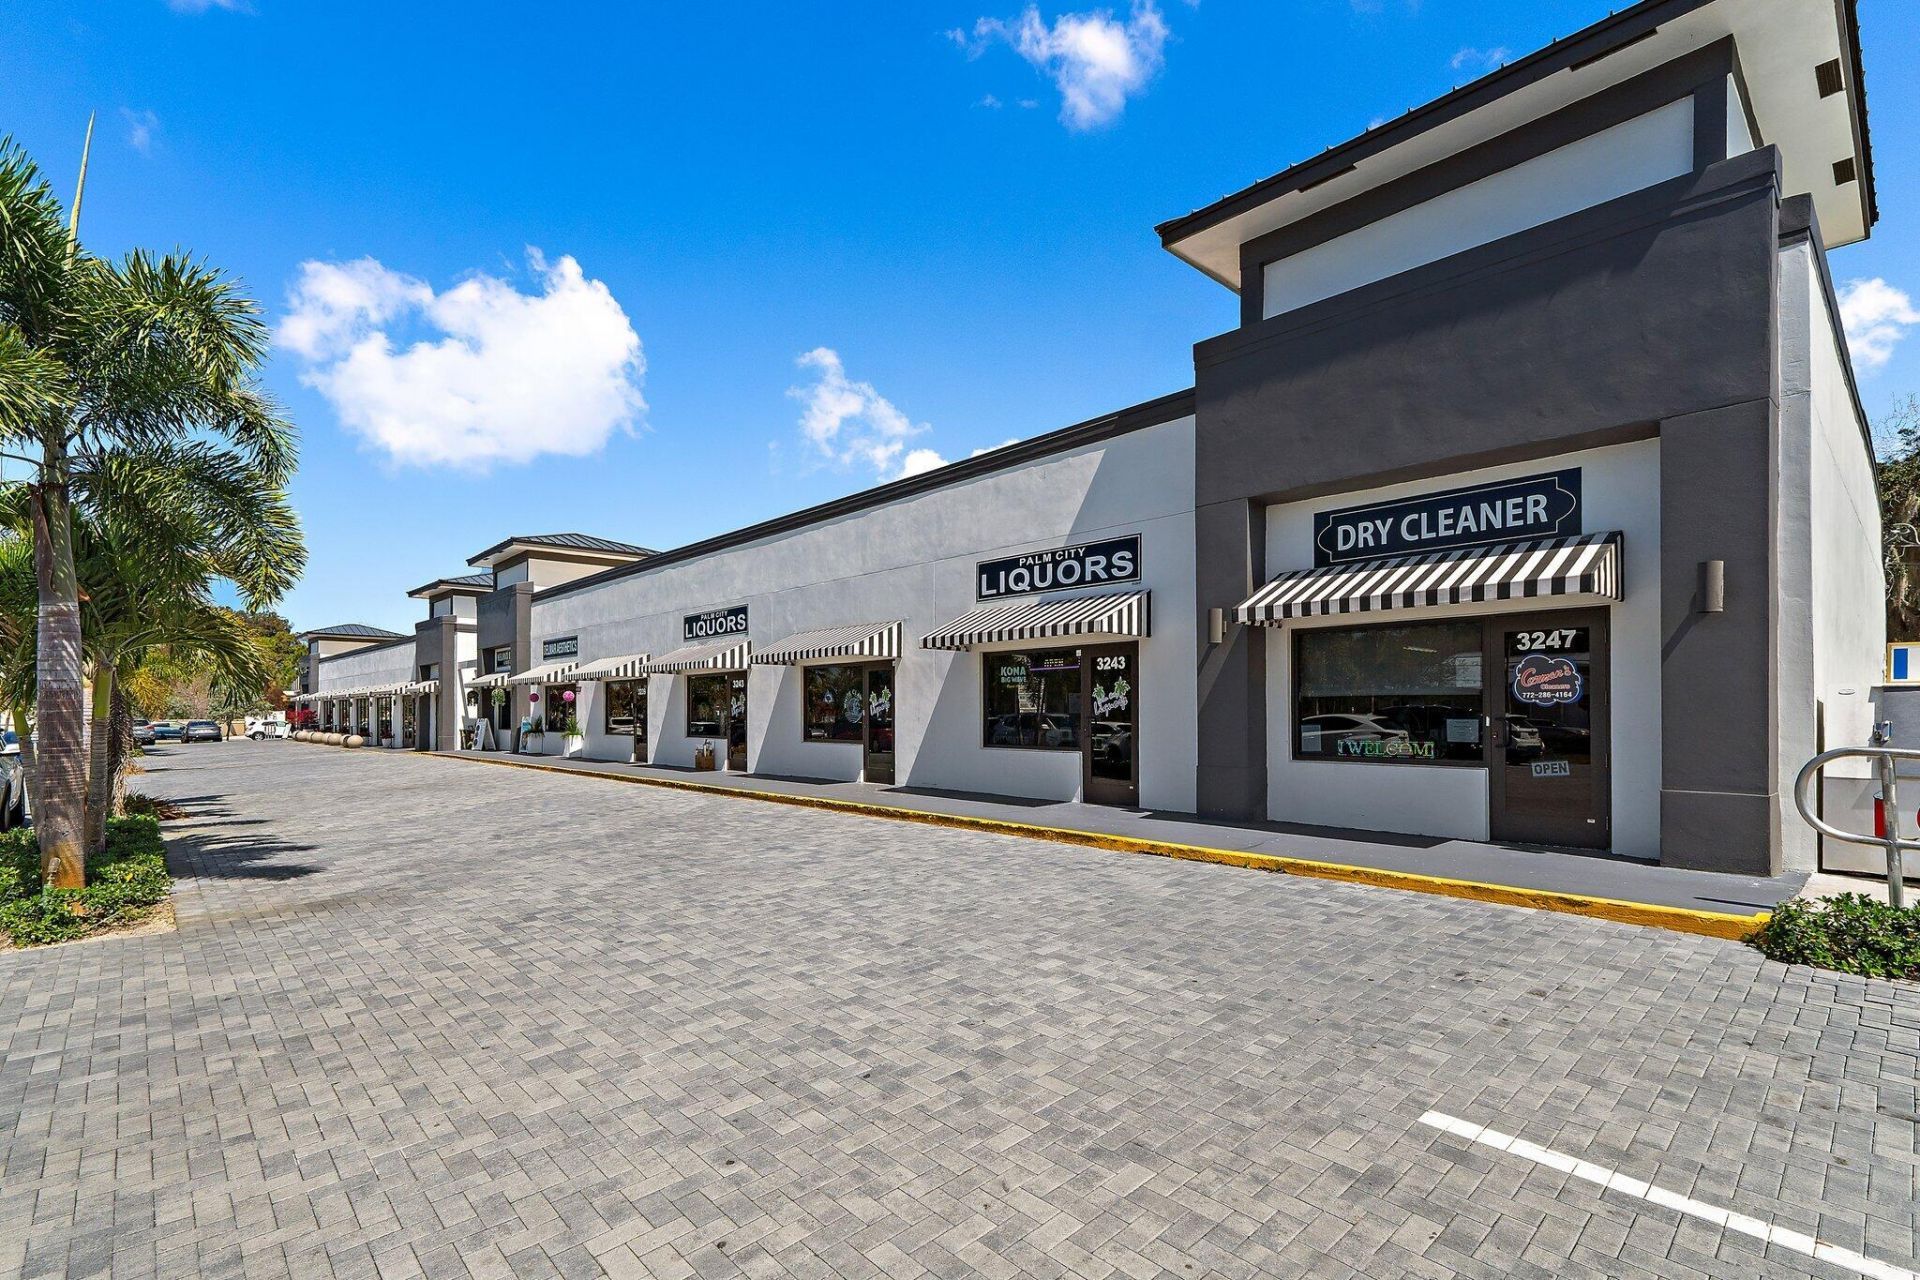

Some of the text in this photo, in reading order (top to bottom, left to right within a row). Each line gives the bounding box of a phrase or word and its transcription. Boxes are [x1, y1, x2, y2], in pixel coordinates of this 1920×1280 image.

[1337, 494, 1549, 551] DRY CLEANER
[1019, 547, 1087, 567] PALM CITY
[981, 550, 1134, 596] LIQUORS
[685, 613, 746, 638] LIQUORS
[700, 610, 728, 621] PALM CITY
[1516, 629, 1577, 651] 3247
[1000, 666, 1026, 677] KONA
[1096, 656, 1126, 670] 3243
[1534, 763, 1568, 775] OPEN
